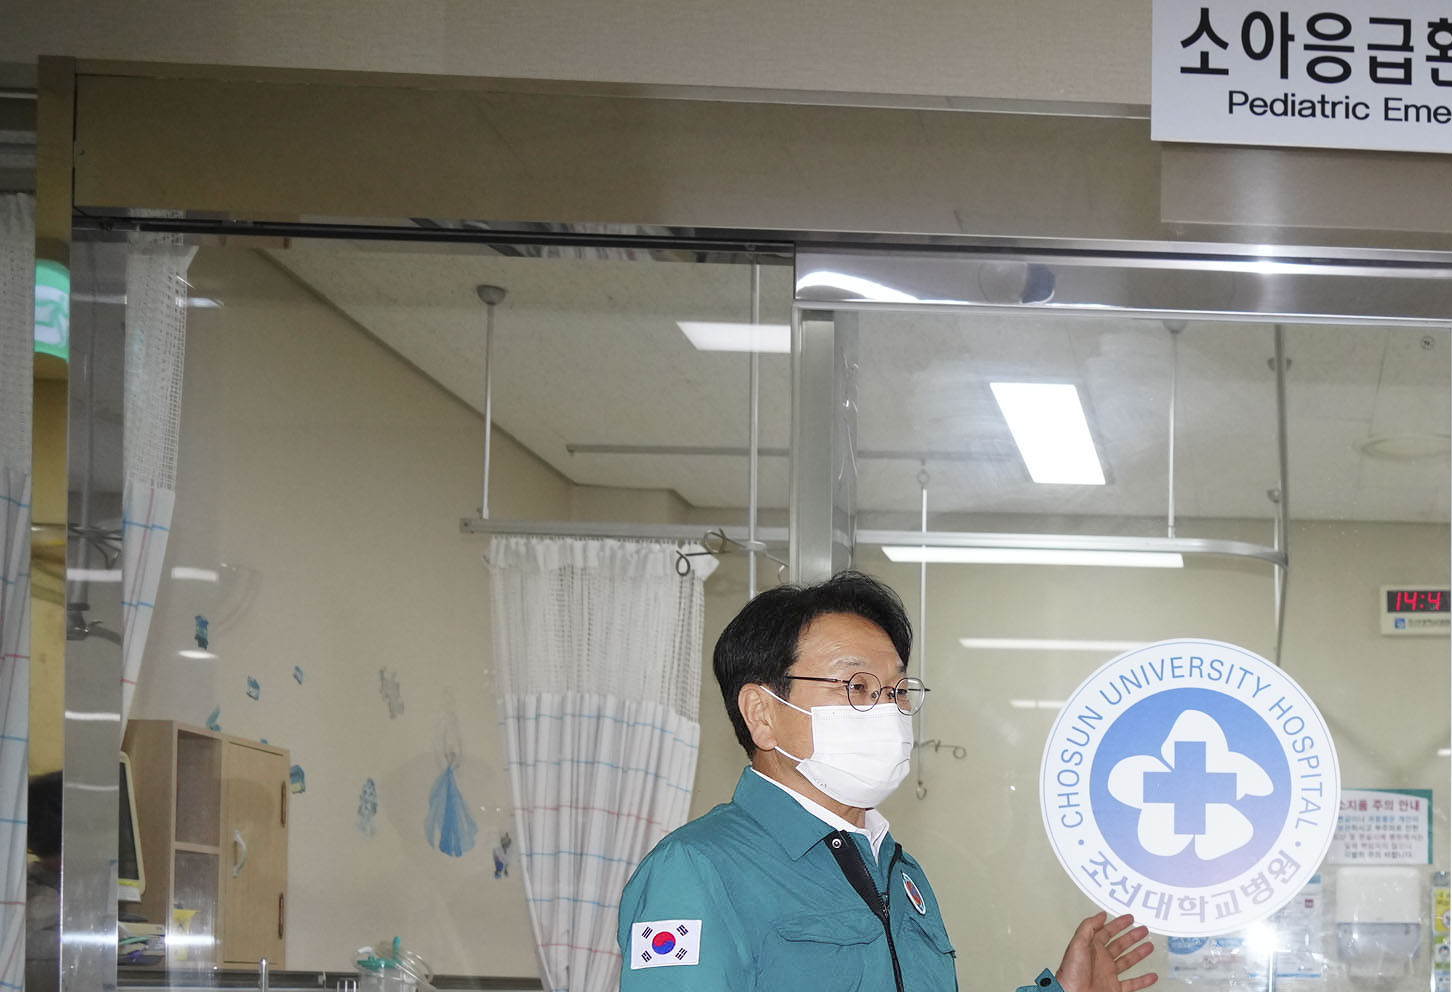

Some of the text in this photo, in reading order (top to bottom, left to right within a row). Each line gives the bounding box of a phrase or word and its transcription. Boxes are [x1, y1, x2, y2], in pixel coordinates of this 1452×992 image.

[1227, 90, 1371, 121] Pediatric
[1396, 591, 1442, 611] 14:4
[1056, 655, 1324, 830] CHOSUN UNIVERSITY HOSPITAL
[1080, 850, 1302, 924] 조선대학교병원
